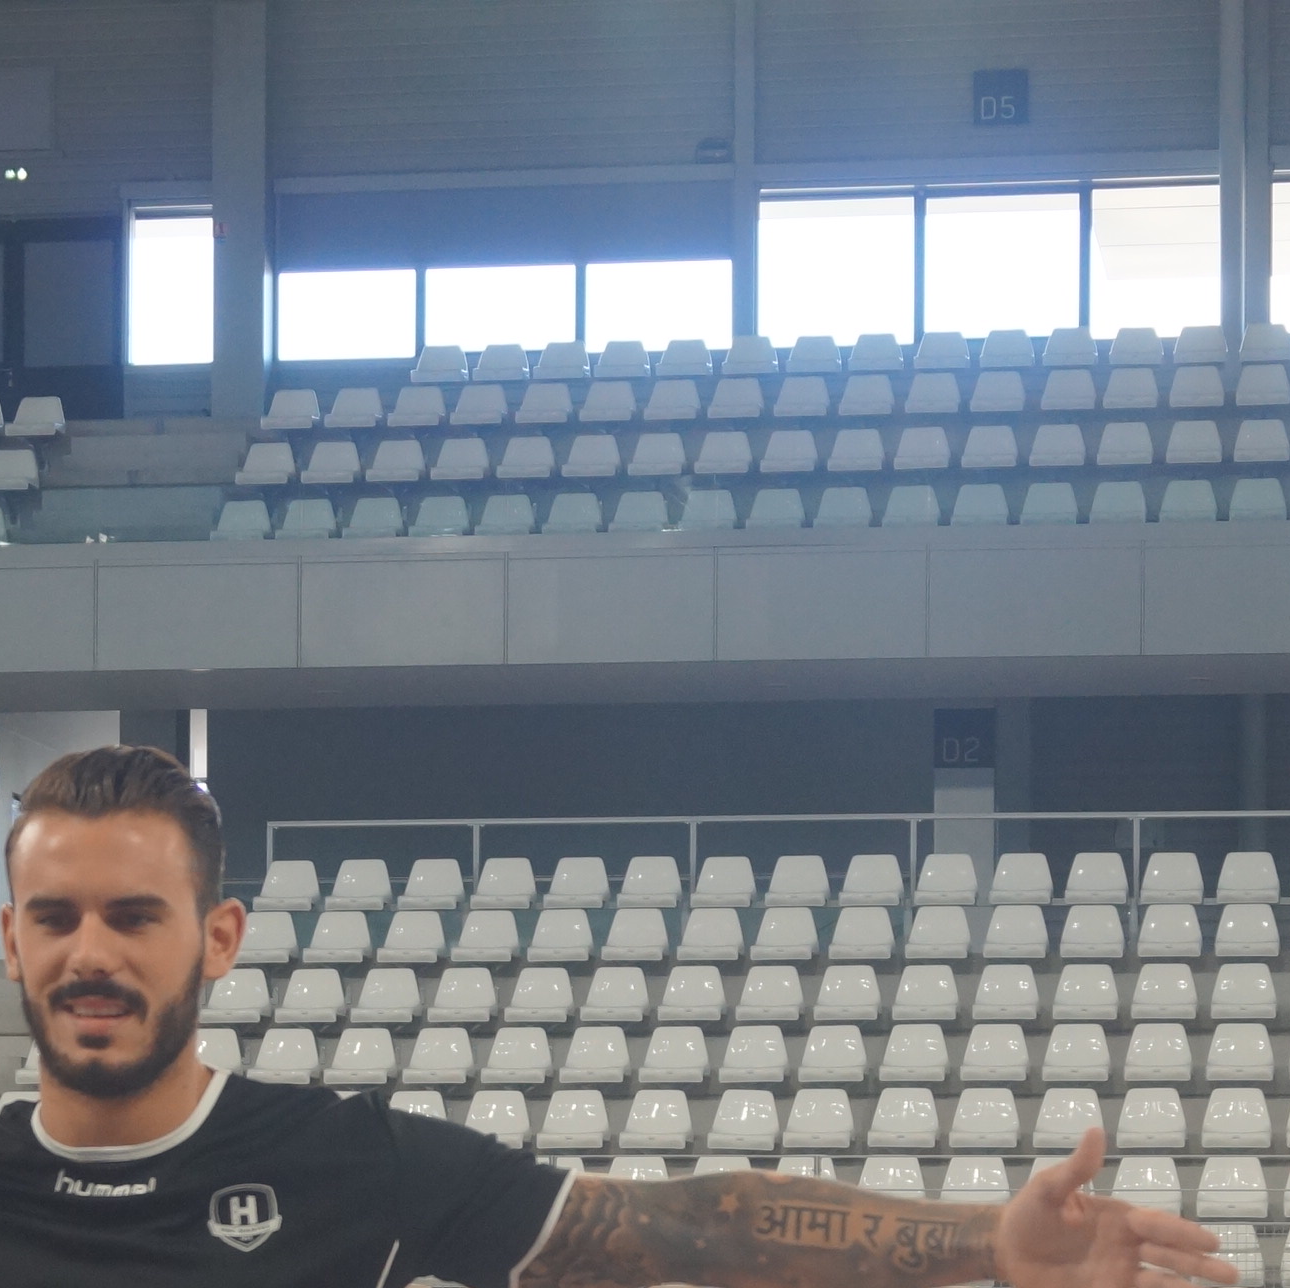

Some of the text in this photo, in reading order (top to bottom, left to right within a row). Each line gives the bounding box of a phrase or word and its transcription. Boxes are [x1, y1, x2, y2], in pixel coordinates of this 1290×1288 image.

[980, 95, 1016, 120] D5
[942, 735, 980, 763] D2
[755, 1204, 851, 1243] आमा
